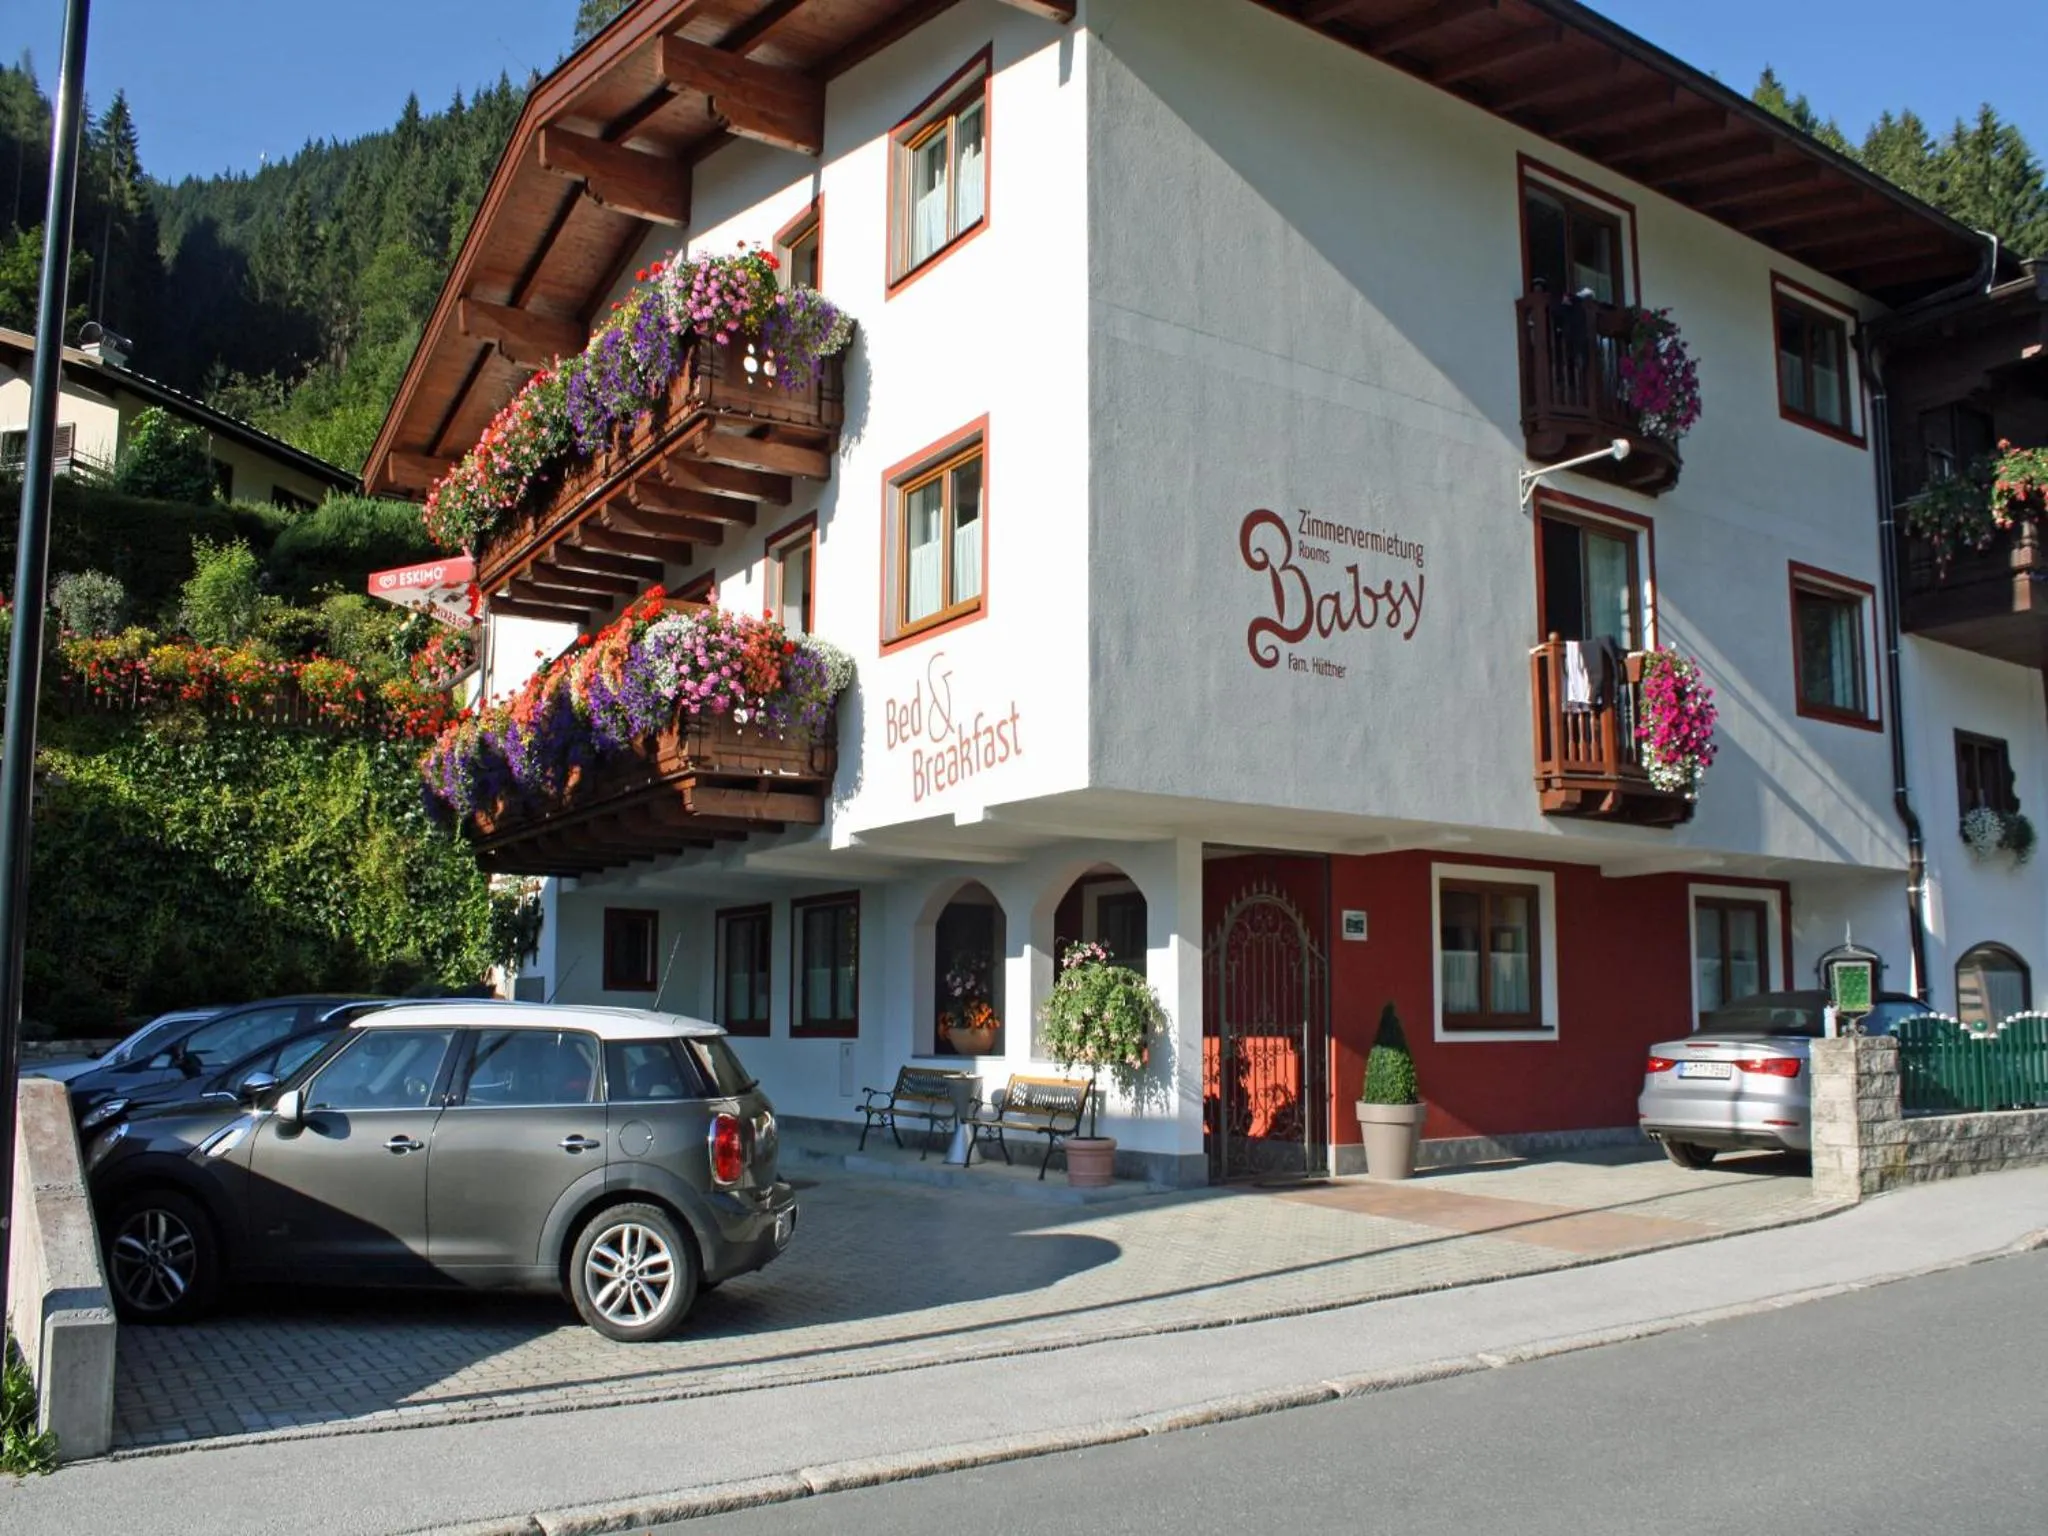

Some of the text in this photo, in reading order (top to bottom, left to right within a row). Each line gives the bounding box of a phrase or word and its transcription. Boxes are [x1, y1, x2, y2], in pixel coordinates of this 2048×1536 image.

[1298, 508, 1424, 569] Zimmervermietung
[1298, 540, 1331, 564] Rooms
[399, 566, 443, 587] ESKIMO
[1239, 508, 1425, 669] Babsy
[1288, 652, 1347, 680] Fam. Hüttner
[886, 651, 955, 751] Bed &
[912, 700, 1022, 803] Breakfast
